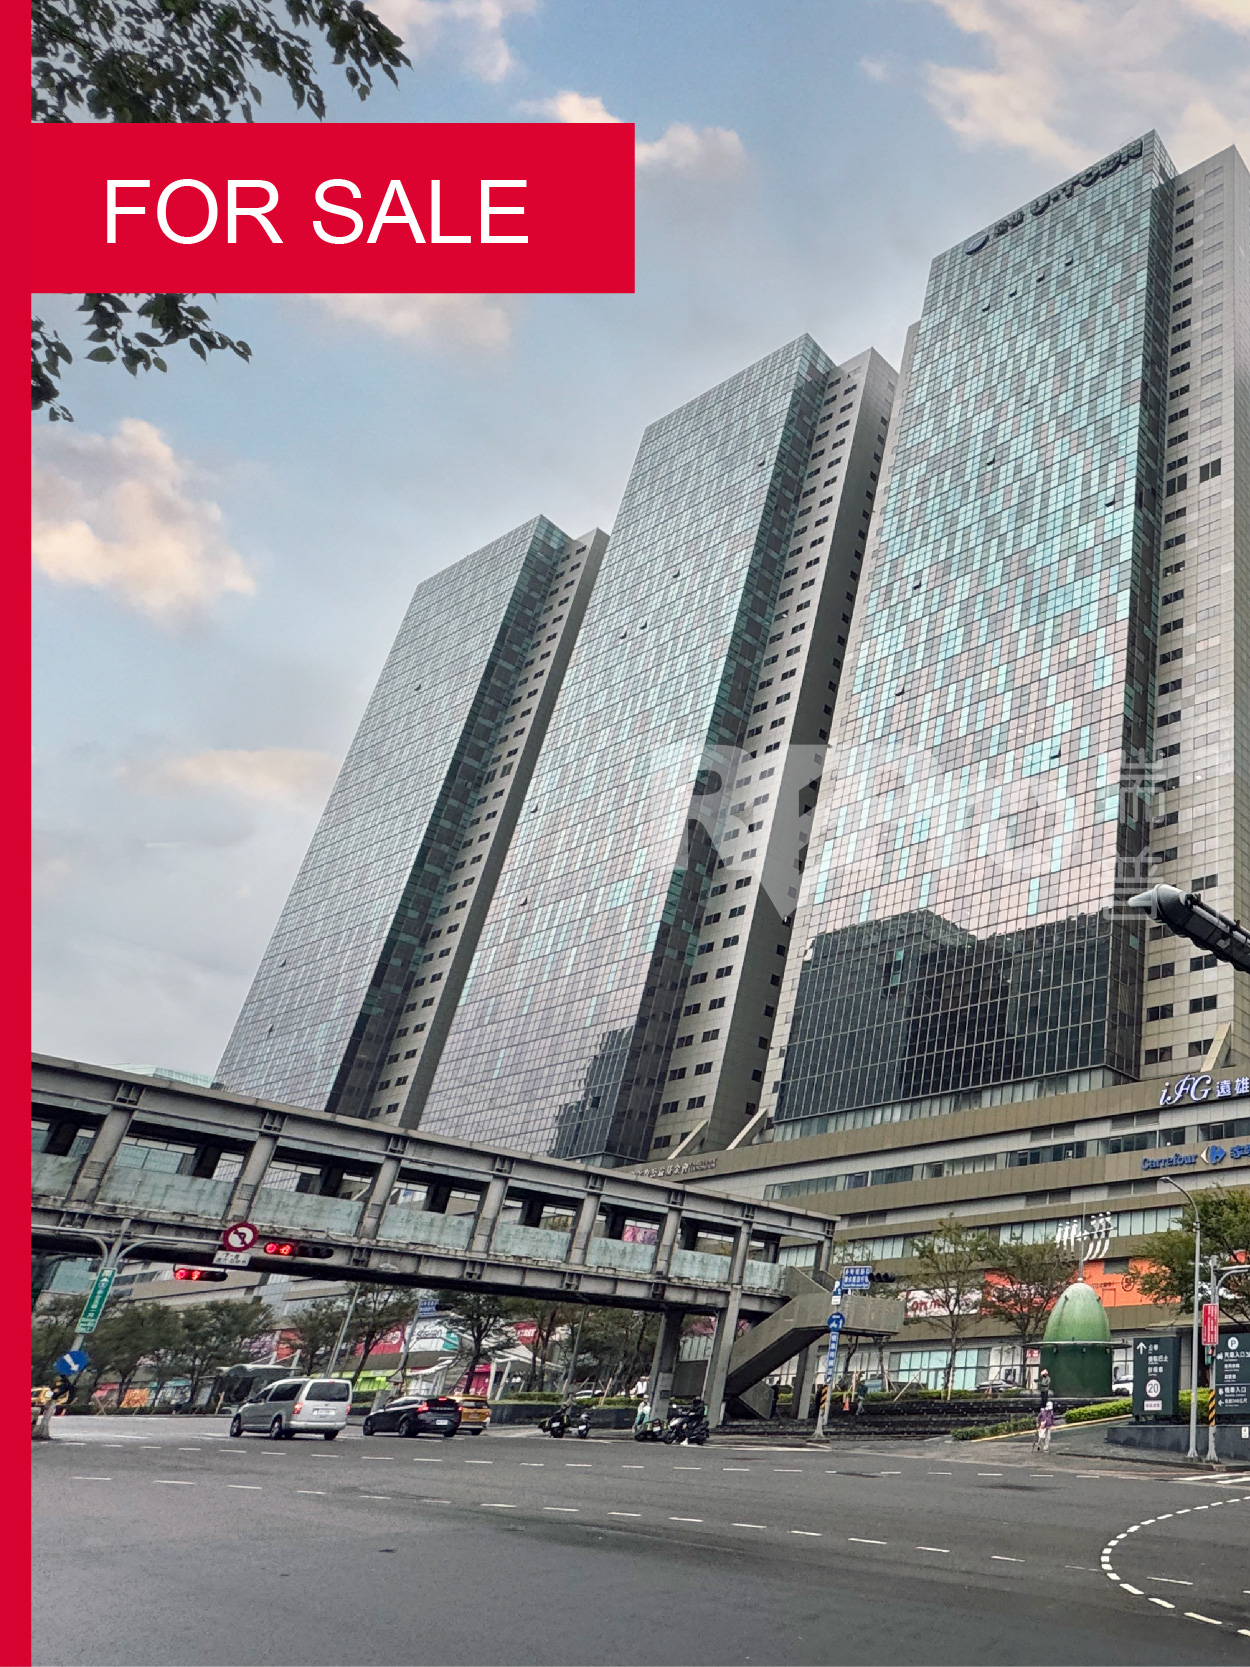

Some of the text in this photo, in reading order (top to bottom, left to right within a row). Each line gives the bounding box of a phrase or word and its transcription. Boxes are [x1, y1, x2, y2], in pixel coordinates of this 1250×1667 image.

[1159, 1074, 1212, 1106] iFG
[1141, 1152, 1199, 1170] Carrefour
[1148, 1383, 1159, 1394] 20
